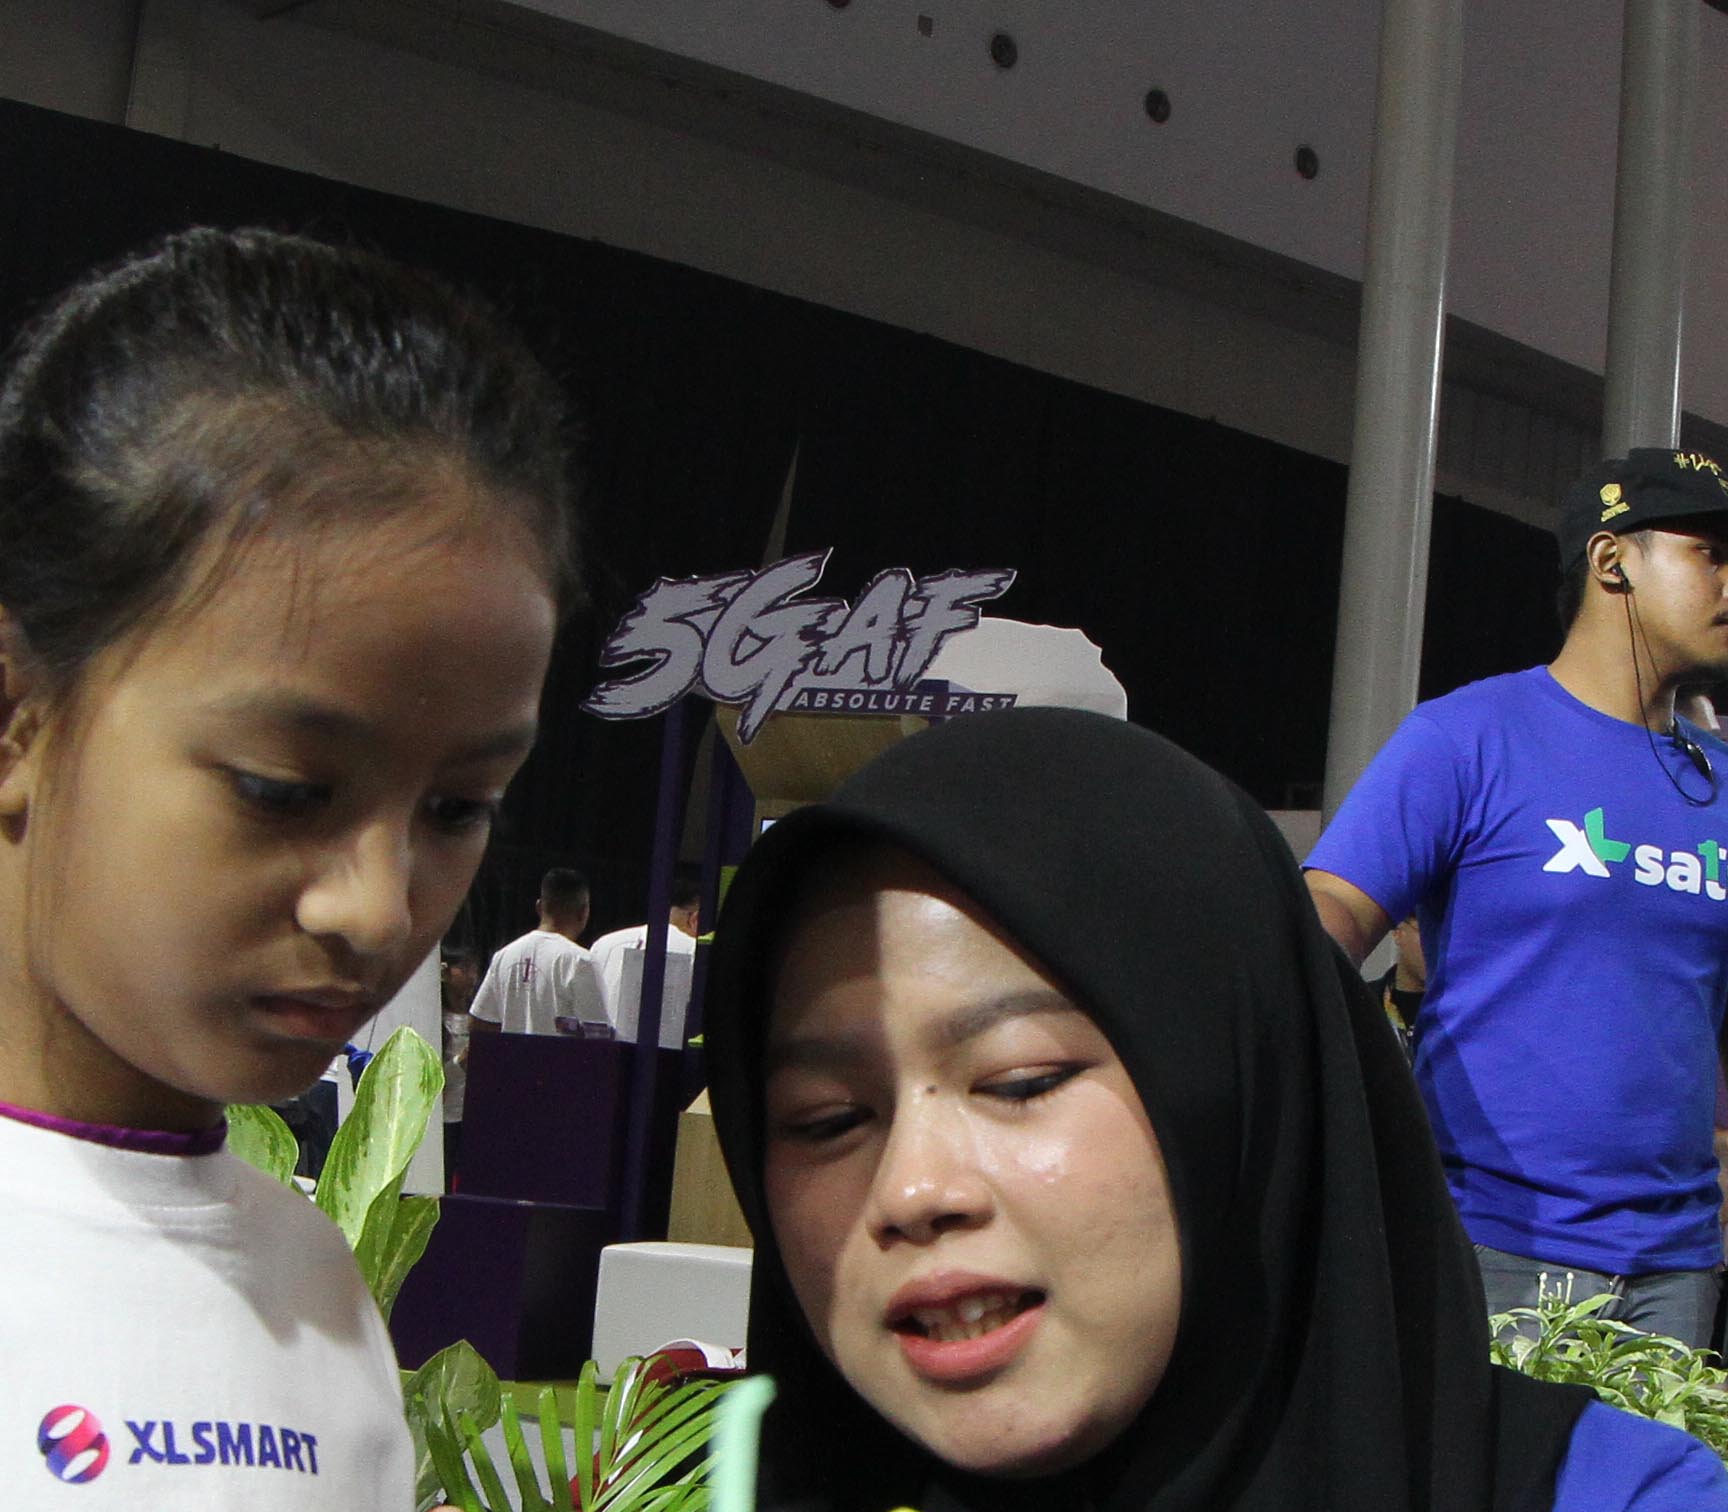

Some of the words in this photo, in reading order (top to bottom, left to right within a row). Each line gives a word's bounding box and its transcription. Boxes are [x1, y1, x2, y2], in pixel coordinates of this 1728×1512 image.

[794, 693, 934, 712] ABSOLUTE
[945, 696, 1018, 712] FAST
[125, 1420, 319, 1475] XLSMART
